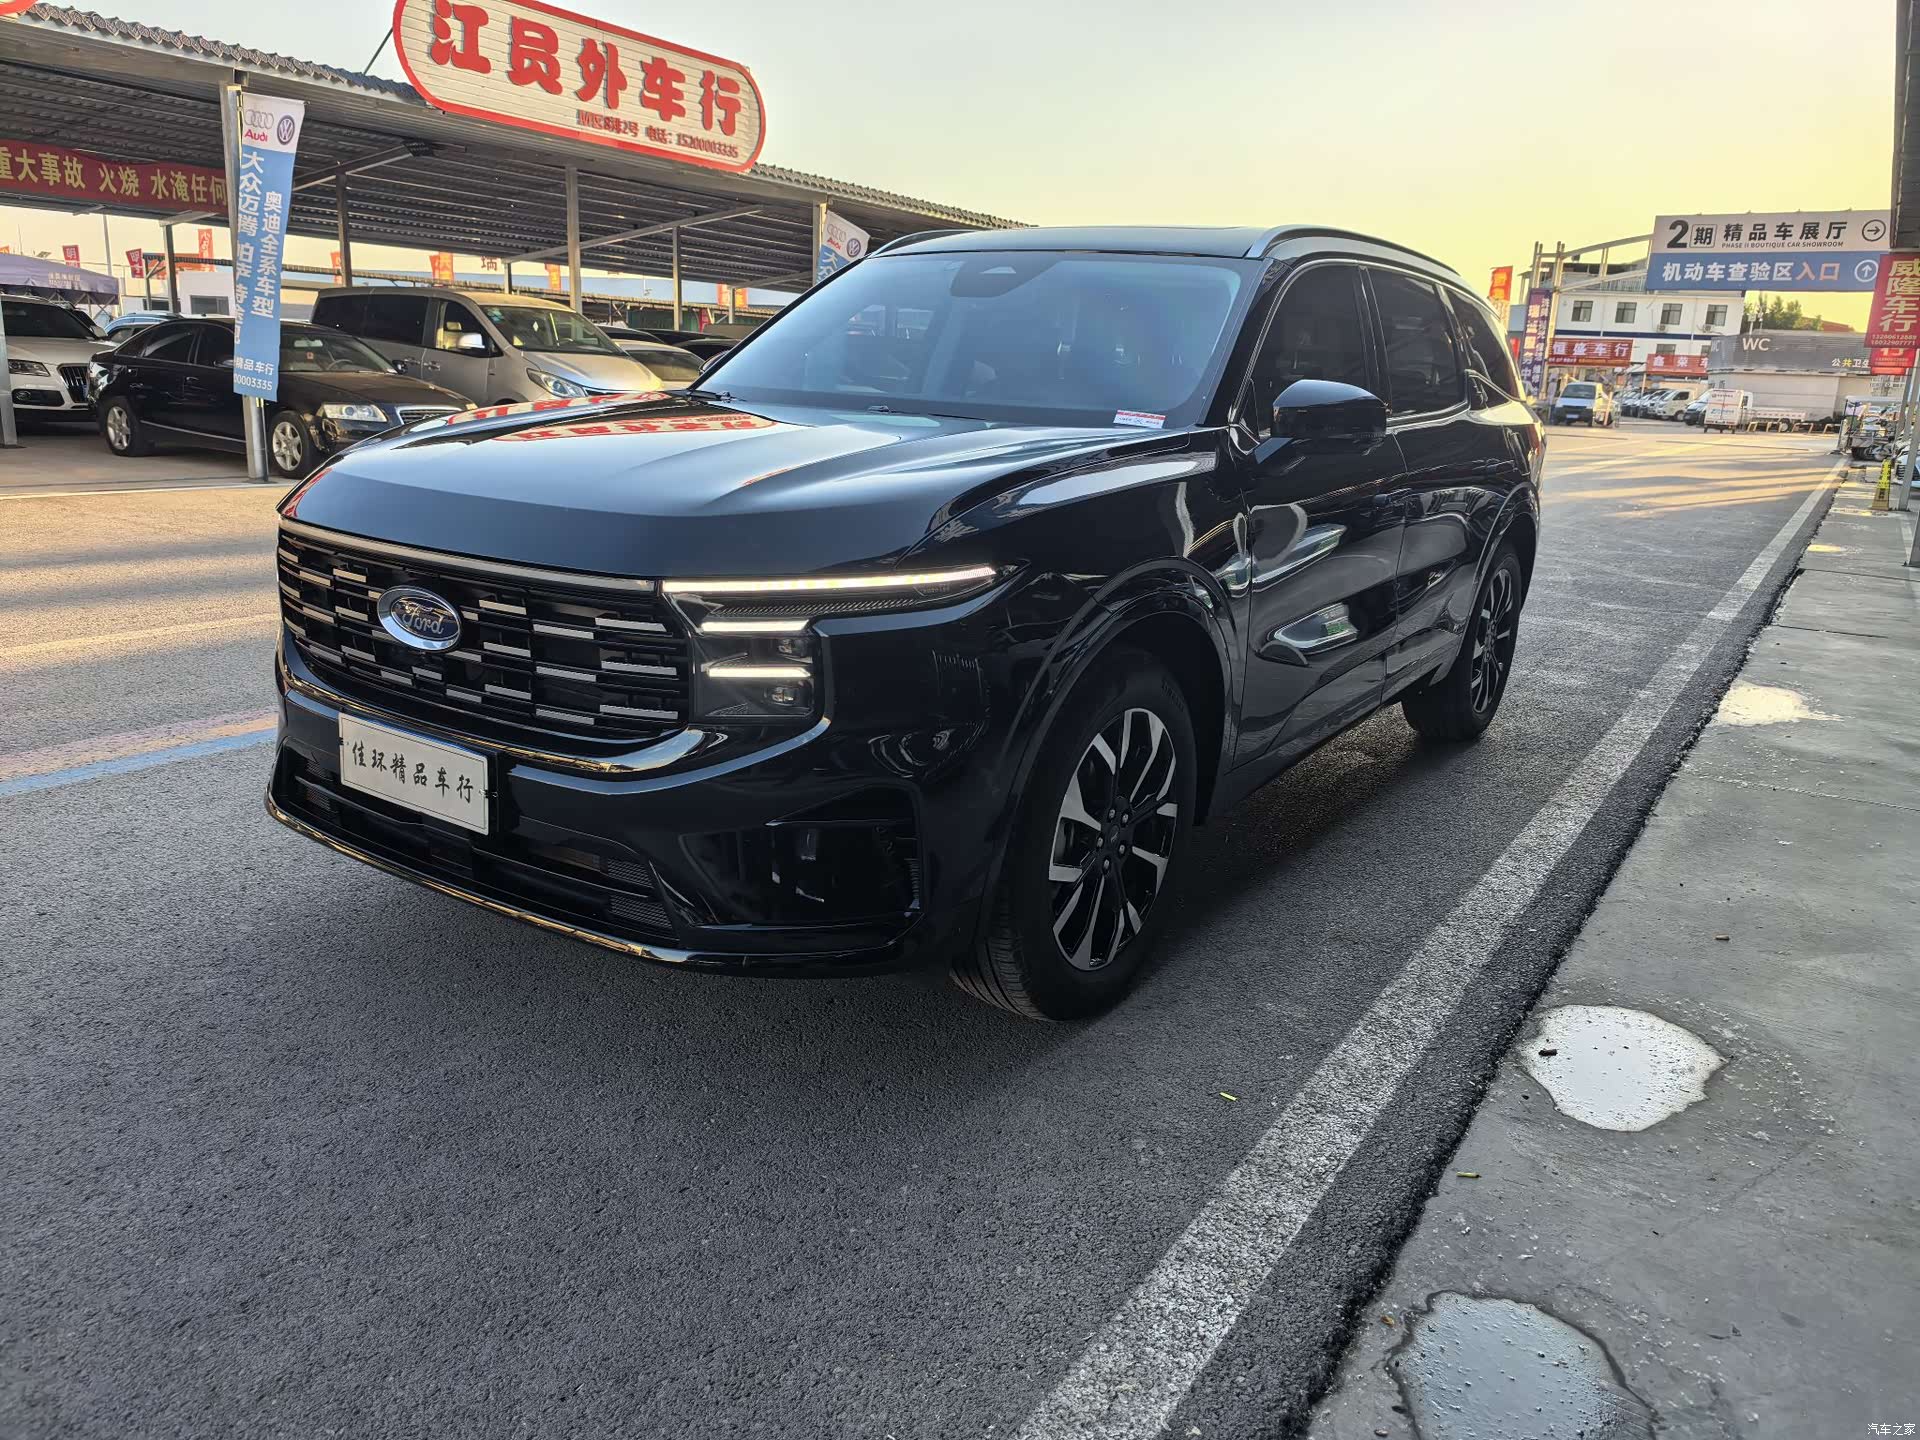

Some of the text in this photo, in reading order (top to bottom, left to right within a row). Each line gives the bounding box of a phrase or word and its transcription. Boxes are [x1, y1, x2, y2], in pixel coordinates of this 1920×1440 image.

[430, 0, 742, 137] 江员外车行
[244, 128, 268, 143] Audi
[98, 163, 140, 198] 火烧
[1723, 221, 1848, 242] 精品车展厅
[251, 191, 283, 319] 奥迪全系车型
[1662, 261, 1841, 282] 机动车查验区入口
[1879, 258, 1920, 333] 威隆车行
[1553, 342, 1630, 358] 恒盛车行
[1742, 337, 1771, 351] WC
[401, 599, 444, 635] Ford
[352, 740, 474, 804] 佳环精品车行
